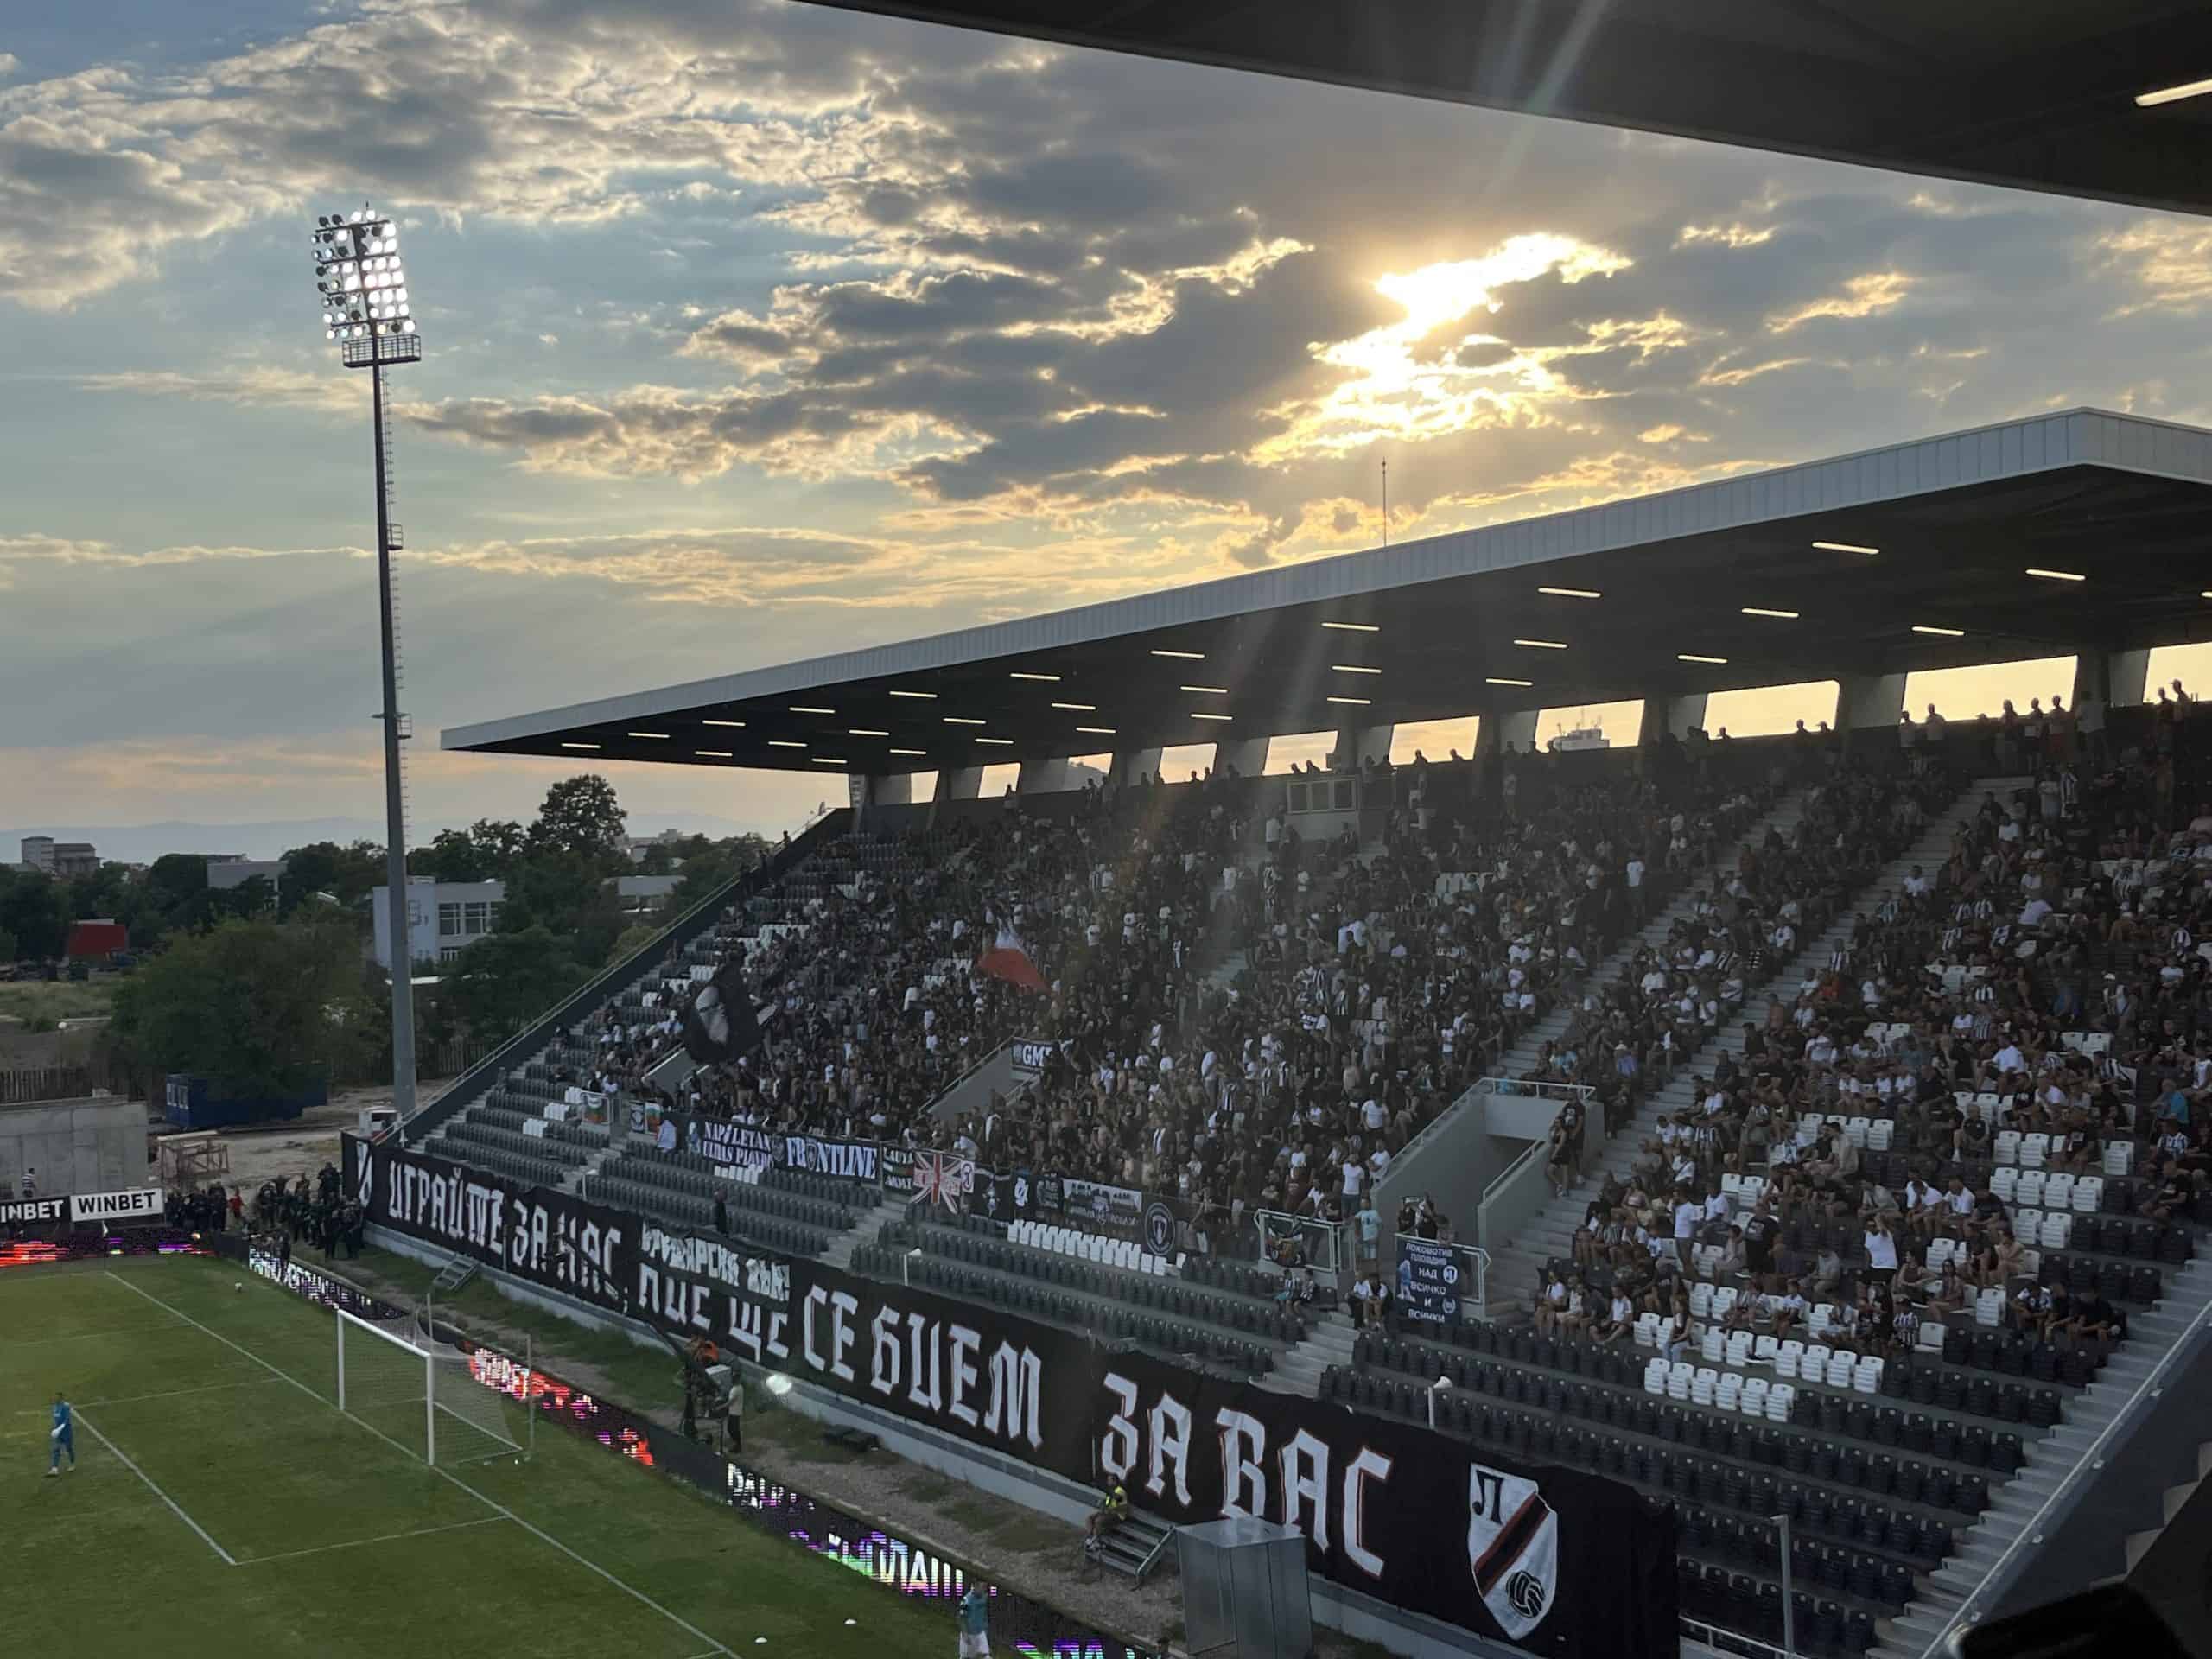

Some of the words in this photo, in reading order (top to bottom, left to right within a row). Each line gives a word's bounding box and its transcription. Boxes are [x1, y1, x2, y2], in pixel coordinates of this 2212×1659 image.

[78, 1192, 156, 1214] WINBET
[1418, 1267, 1438, 1280] НАД
[1409, 1281, 1446, 1296] ВСИЧКО
[1424, 1298, 1432, 1308] И
[1408, 1308, 1446, 1324] ВСИЧКИ
[512, 1198, 548, 1274] ЗА
[803, 1283, 859, 1382] СЕ
[869, 1304, 1044, 1452] БИЕМ
[1101, 1370, 1192, 1507] ЗА
[1215, 1407, 1393, 1579] ВАС
